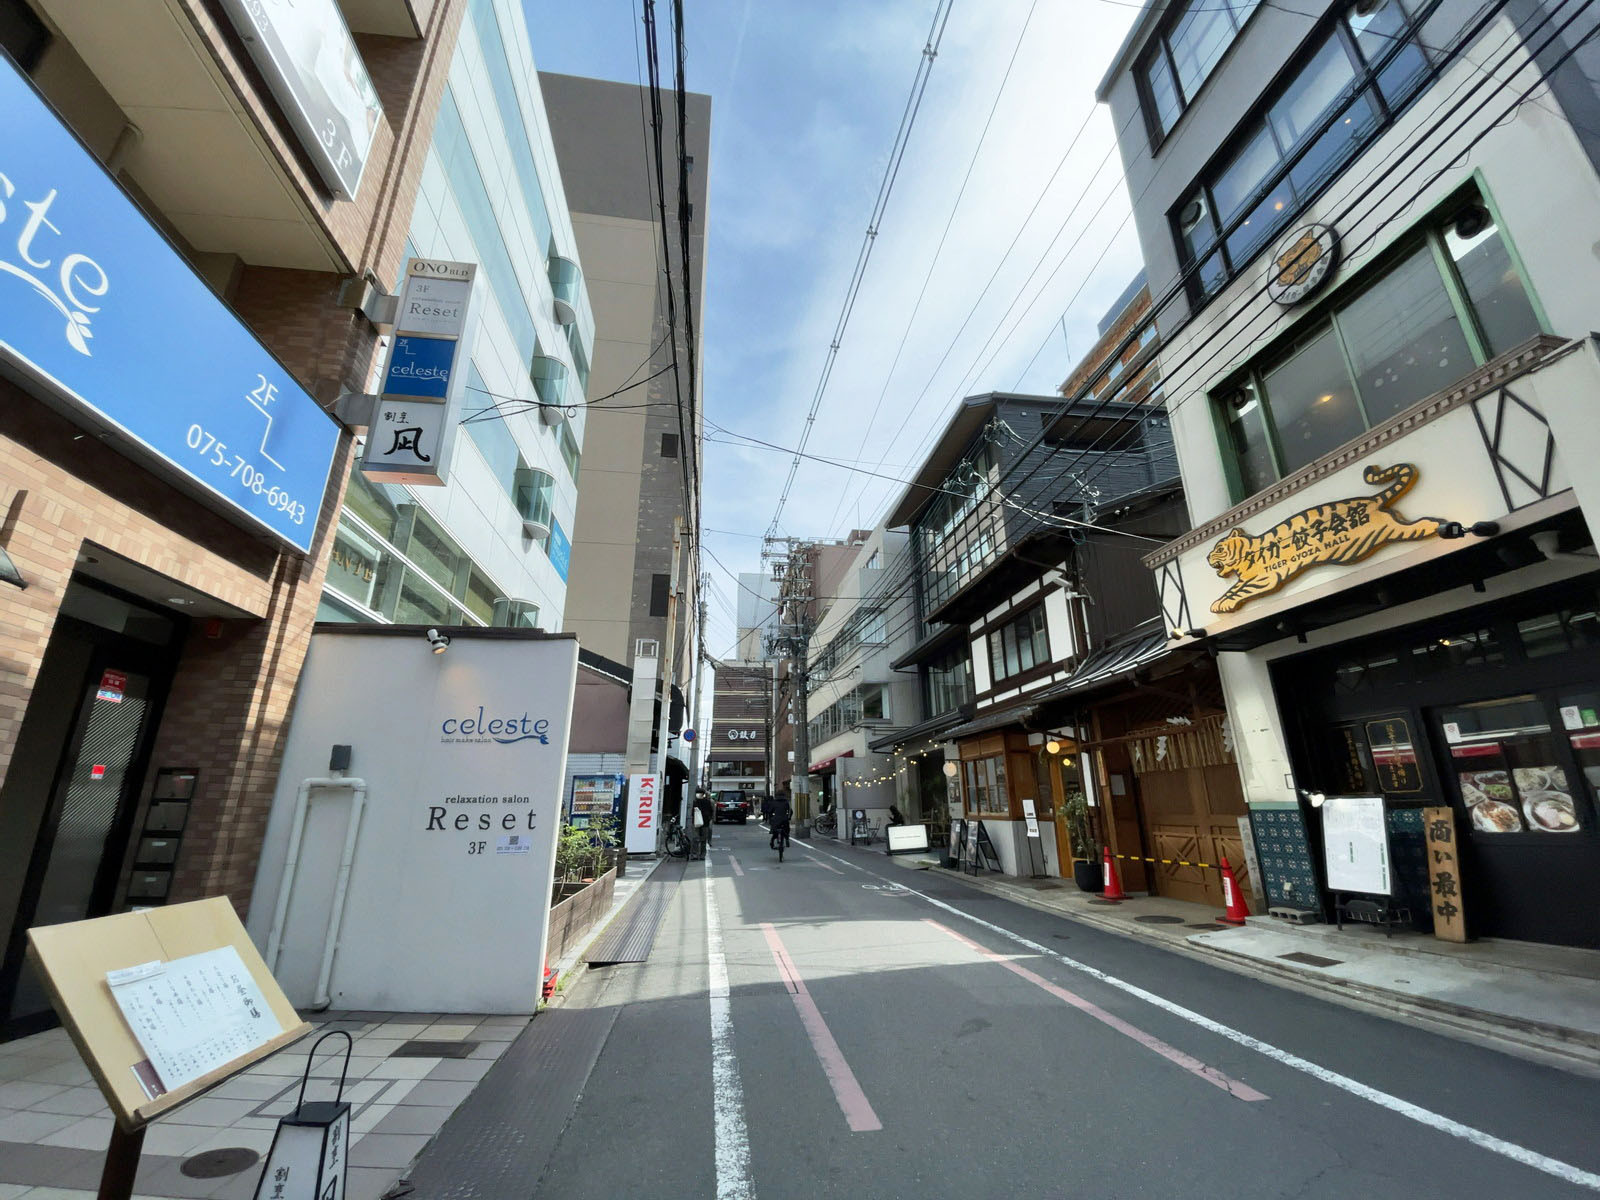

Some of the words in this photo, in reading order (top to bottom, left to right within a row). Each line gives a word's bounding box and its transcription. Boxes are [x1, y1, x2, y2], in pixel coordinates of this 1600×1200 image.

[321, 118, 353, 170] 3F
[413, 262, 448, 275] ONO
[416, 285, 431, 293] 3F
[409, 302, 459, 318] Reset
[391, 362, 448, 377] celeste
[251, 373, 279, 406] 2F
[384, 411, 409, 424] 割烹
[383, 427, 430, 462] 凪
[187, 423, 305, 525] 075-708-6943
[1244, 502, 1369, 566] タイガー餃子会館
[1264, 559, 1287, 573] TIGER
[1290, 546, 1321, 563] GYOZA
[1324, 534, 1350, 549] HALL
[442, 706, 549, 735] celeste
[445, 794, 498, 804] relaxation
[502, 794, 530, 804] salon
[425, 806, 537, 831] Reset
[468, 841, 487, 855] 3F
[1429, 819, 1459, 926] 商い最中
